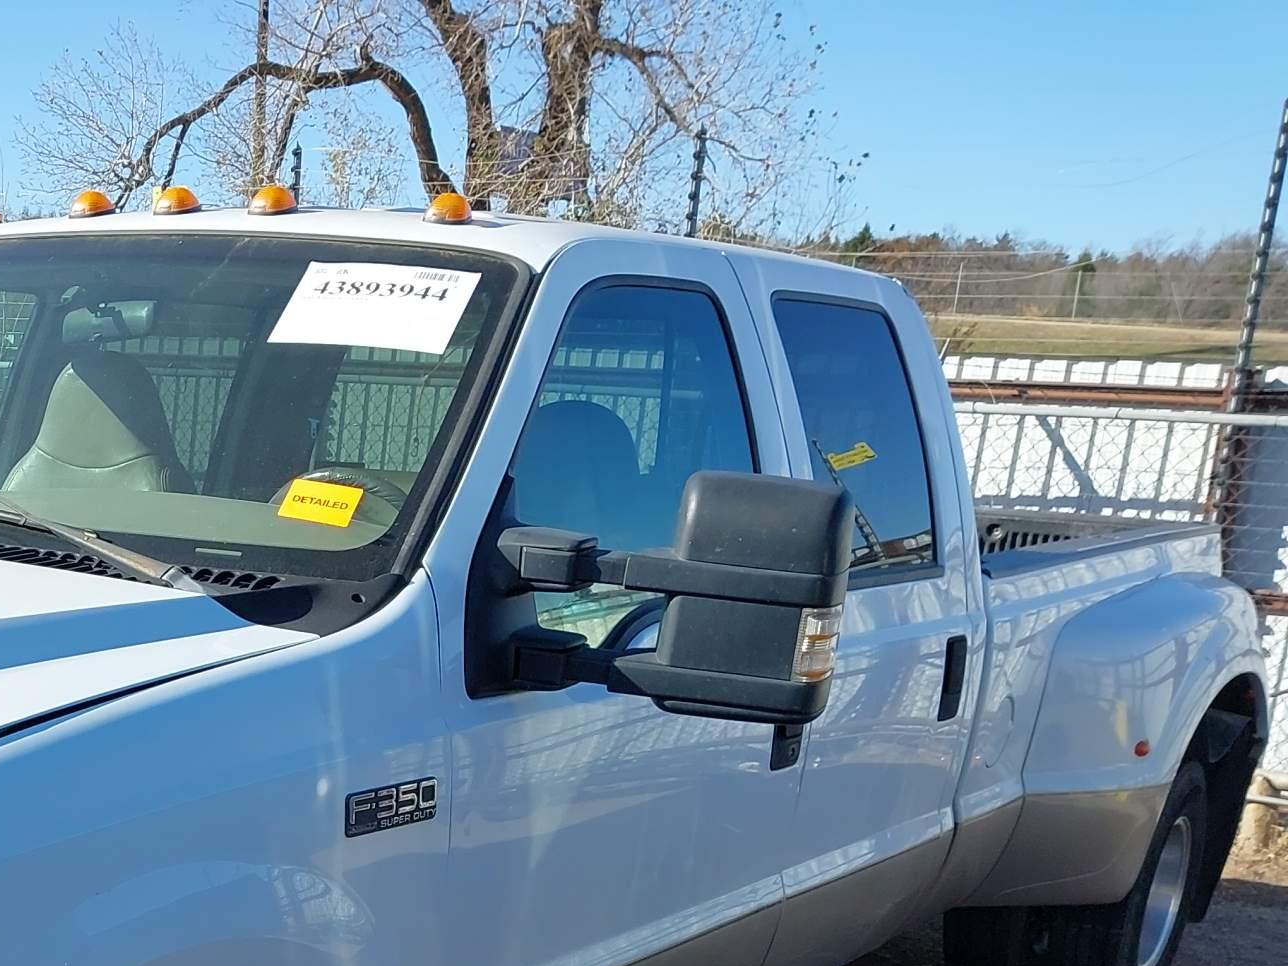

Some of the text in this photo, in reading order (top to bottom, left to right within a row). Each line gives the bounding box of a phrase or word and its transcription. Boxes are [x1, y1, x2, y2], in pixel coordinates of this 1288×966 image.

[314, 280, 449, 301] 43893944
[292, 494, 349, 510] DETAILED
[349, 779, 438, 825] F-350
[379, 808, 437, 828] SUPER DUTY
